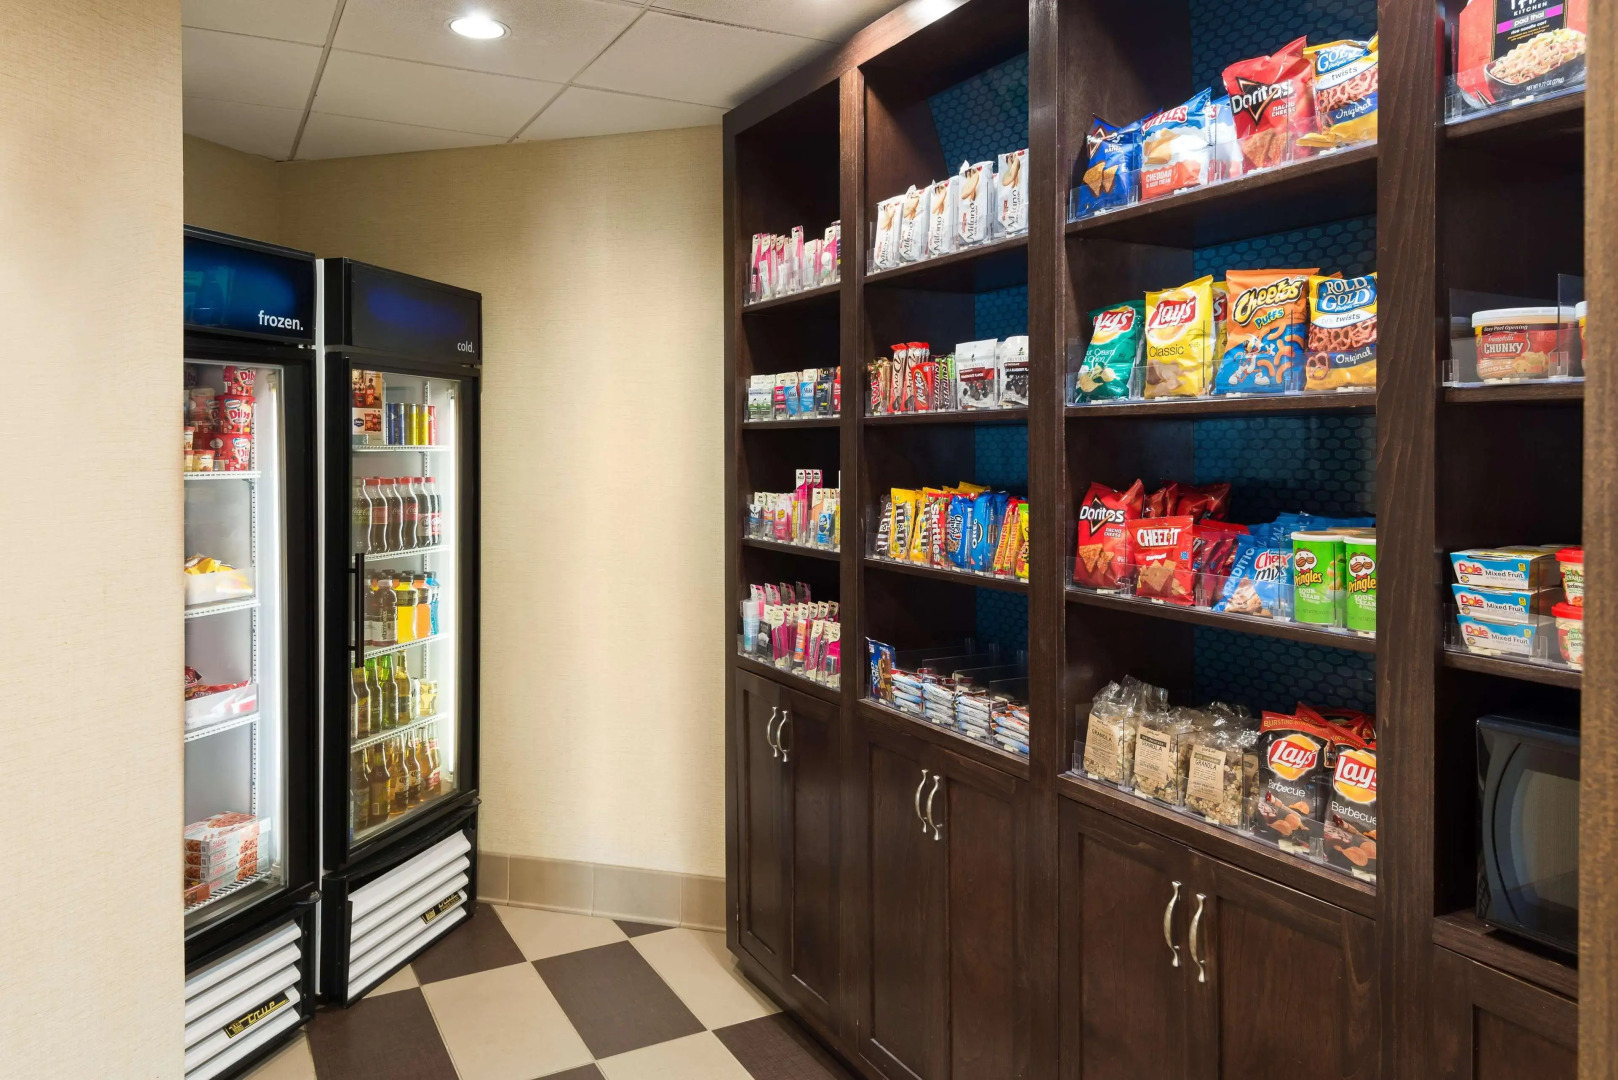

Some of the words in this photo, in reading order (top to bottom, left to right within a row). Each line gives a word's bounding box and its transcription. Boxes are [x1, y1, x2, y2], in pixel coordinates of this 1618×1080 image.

[1514, 2, 1548, 16] KITCHEN
[1514, 15, 1529, 27] pad
[1530, 11, 1544, 21] thai
[1331, 66, 1358, 80] twists
[1232, 79, 1294, 114] Doritos
[1335, 98, 1373, 119] Original
[1143, 107, 1187, 130] UFFLES
[1146, 169, 1173, 182] CHEDDAR
[966, 202, 976, 241] Milano
[933, 216, 942, 252] Milano
[1326, 278, 1368, 294] ROLD
[1233, 278, 1303, 324] Cheetos
[1322, 288, 1371, 311] GOLD
[258, 310, 304, 331] frozen.
[1148, 296, 1196, 329] Lay's
[1254, 308, 1284, 329] Puffs
[1336, 313, 1360, 323] twists
[457, 340, 475, 354] cold.
[1149, 344, 1184, 358] Classic
[1336, 347, 1372, 364] Original
[1484, 342, 1524, 354] CHUNKY
[1080, 505, 1124, 523] Doritos
[930, 503, 941, 563] Skittles
[954, 514, 963, 536] Chips
[1255, 549, 1292, 570] Chex
[1224, 547, 1254, 598] TRADITIO
[1255, 564, 1284, 581] mix
[1459, 562, 1482, 575] Dole
[1485, 570, 1506, 578] Mixed
[1294, 570, 1322, 588] Pringles
[1348, 575, 1376, 593] Pringle
[1460, 594, 1484, 606] Dole
[1486, 602, 1508, 610] Mixed
[1466, 624, 1488, 637] Dole
[1492, 634, 1512, 642] Mixed
[1513, 636, 1528, 645] Fruit
[1264, 718, 1294, 728] BURSTING
[1141, 740, 1163, 753] GRANOLA
[1272, 742, 1316, 768] Lay's
[1194, 758, 1217, 771] GRANOLA
[1335, 756, 1376, 788] Lay
